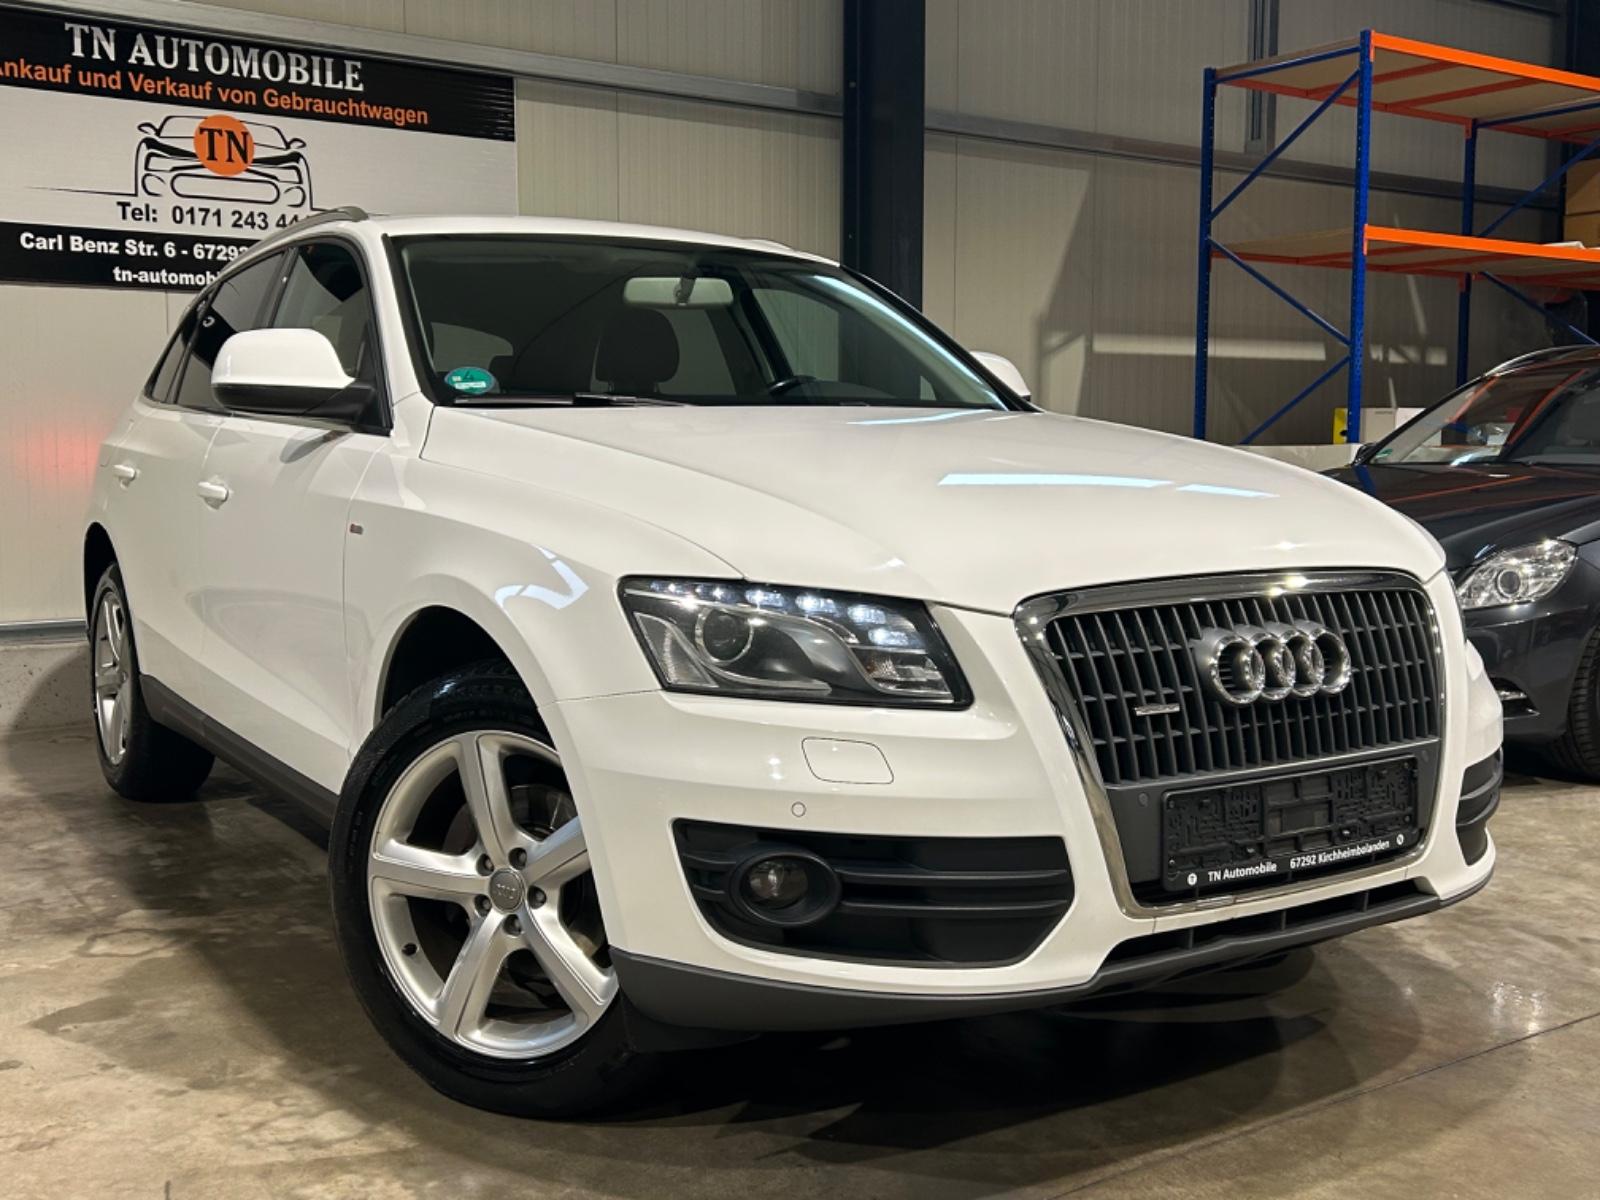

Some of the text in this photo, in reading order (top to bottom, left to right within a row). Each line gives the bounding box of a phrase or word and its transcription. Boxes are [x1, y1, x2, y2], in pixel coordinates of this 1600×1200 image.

[64, 22, 364, 91] TN AUTOMOBILE
[78, 70, 122, 90] und
[128, 71, 213, 100] Verkauf
[217, 86, 257, 105] von
[263, 88, 428, 126] Gebrauchtwagen
[199, 128, 249, 164] TN
[117, 201, 157, 222] Tel:
[172, 205, 222, 227] 0171
[231, 210, 268, 230] 243
[20, 232, 63, 250] Carl
[69, 235, 120, 254] Benz
[125, 239, 158, 256] Str.
[164, 241, 176, 257] 6
[112, 266, 220, 285] tn-automob
[1289, 840, 1390, 869] 67292 Kirchheimbolanden
[1208, 861, 1278, 882] TN Automobile
